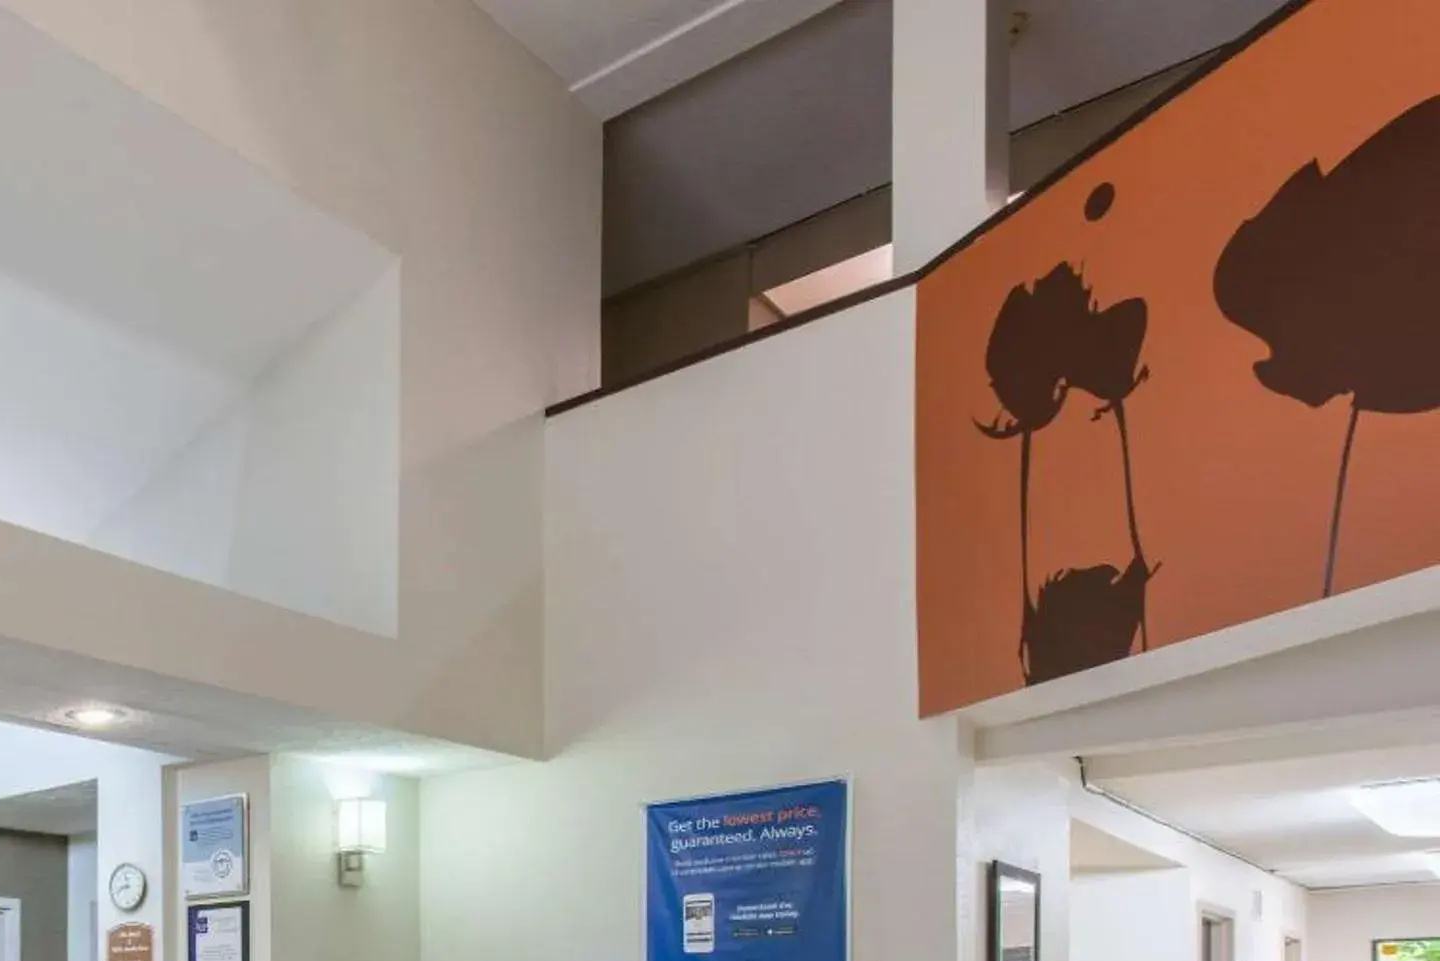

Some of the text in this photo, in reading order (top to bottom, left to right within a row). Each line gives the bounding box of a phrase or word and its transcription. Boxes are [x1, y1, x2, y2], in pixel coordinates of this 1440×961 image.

[668, 819, 693, 832] Get
[696, 816, 721, 830] the
[723, 809, 775, 826] lowest
[670, 824, 818, 853] guaranteed. Always.
